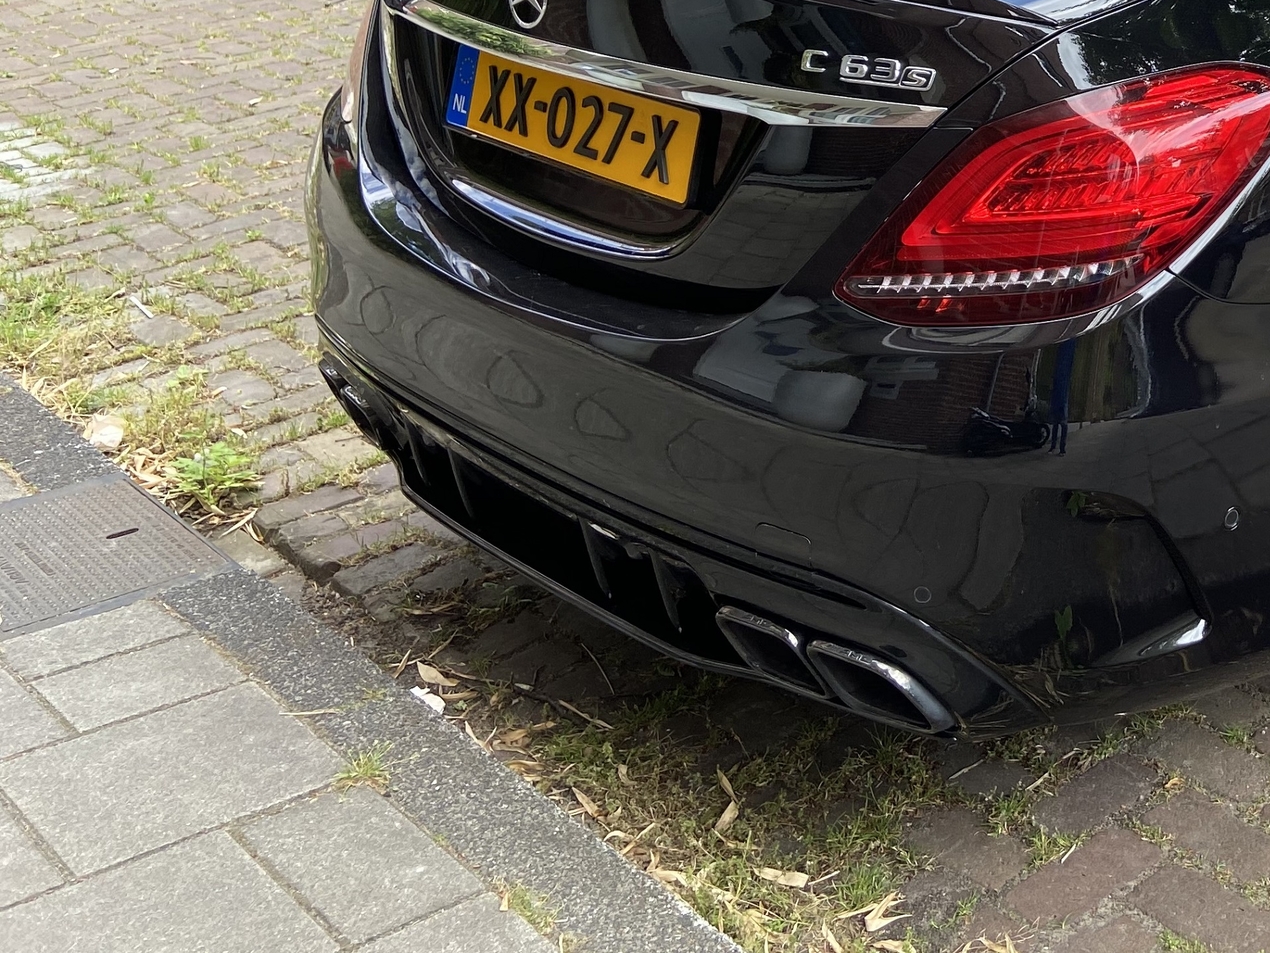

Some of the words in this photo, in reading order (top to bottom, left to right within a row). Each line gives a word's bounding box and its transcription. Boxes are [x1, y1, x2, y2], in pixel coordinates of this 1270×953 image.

[800, 48, 829, 73] C
[452, 93, 467, 115] NL
[479, 64, 680, 185] XX-027-X
